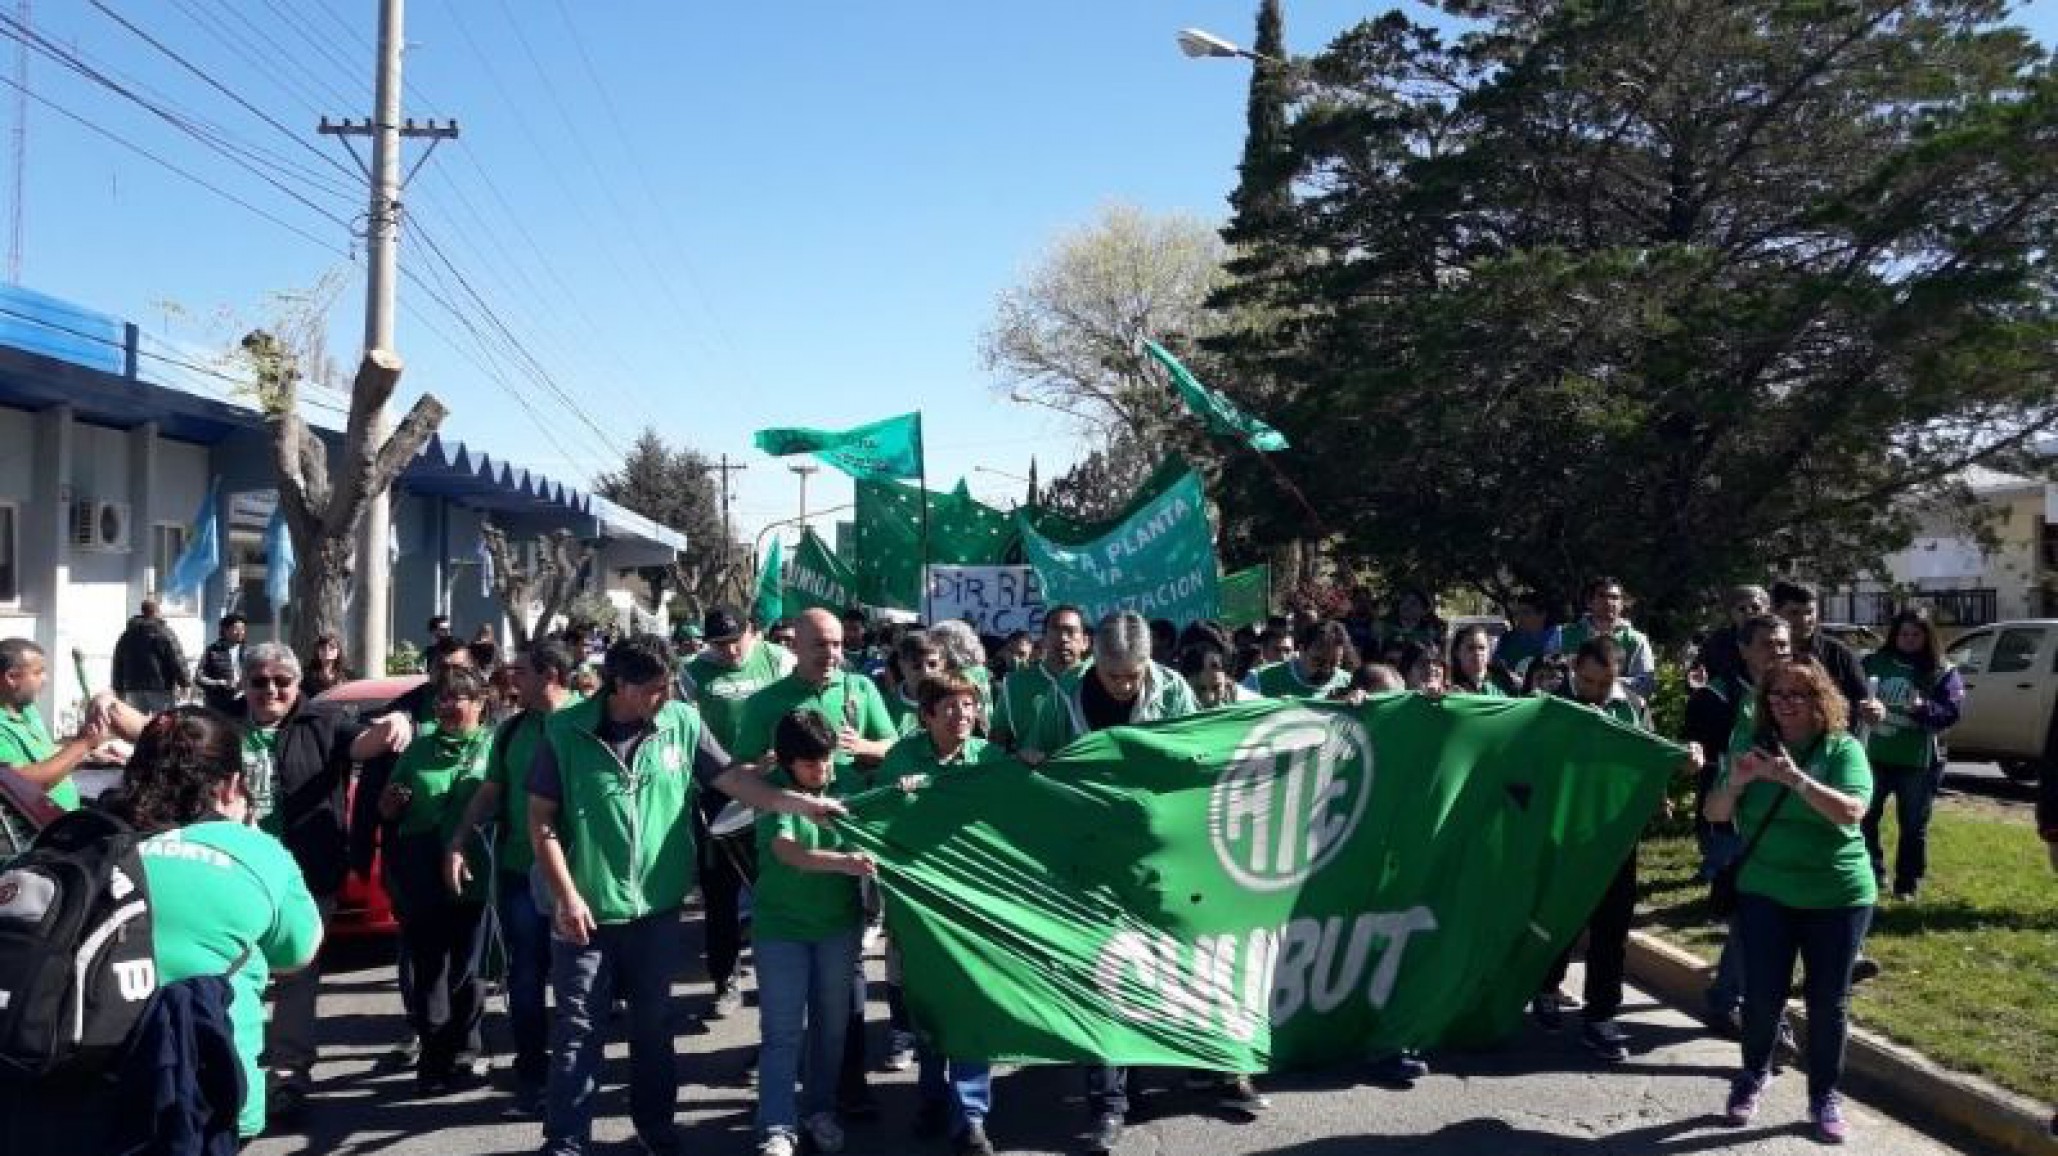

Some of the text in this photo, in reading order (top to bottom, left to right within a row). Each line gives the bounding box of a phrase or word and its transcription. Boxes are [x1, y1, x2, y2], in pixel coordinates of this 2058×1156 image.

[1107, 498, 1191, 564] PLANTA
[1224, 725, 1357, 874] ATE
[1095, 905, 1438, 1041] CHUBUT
